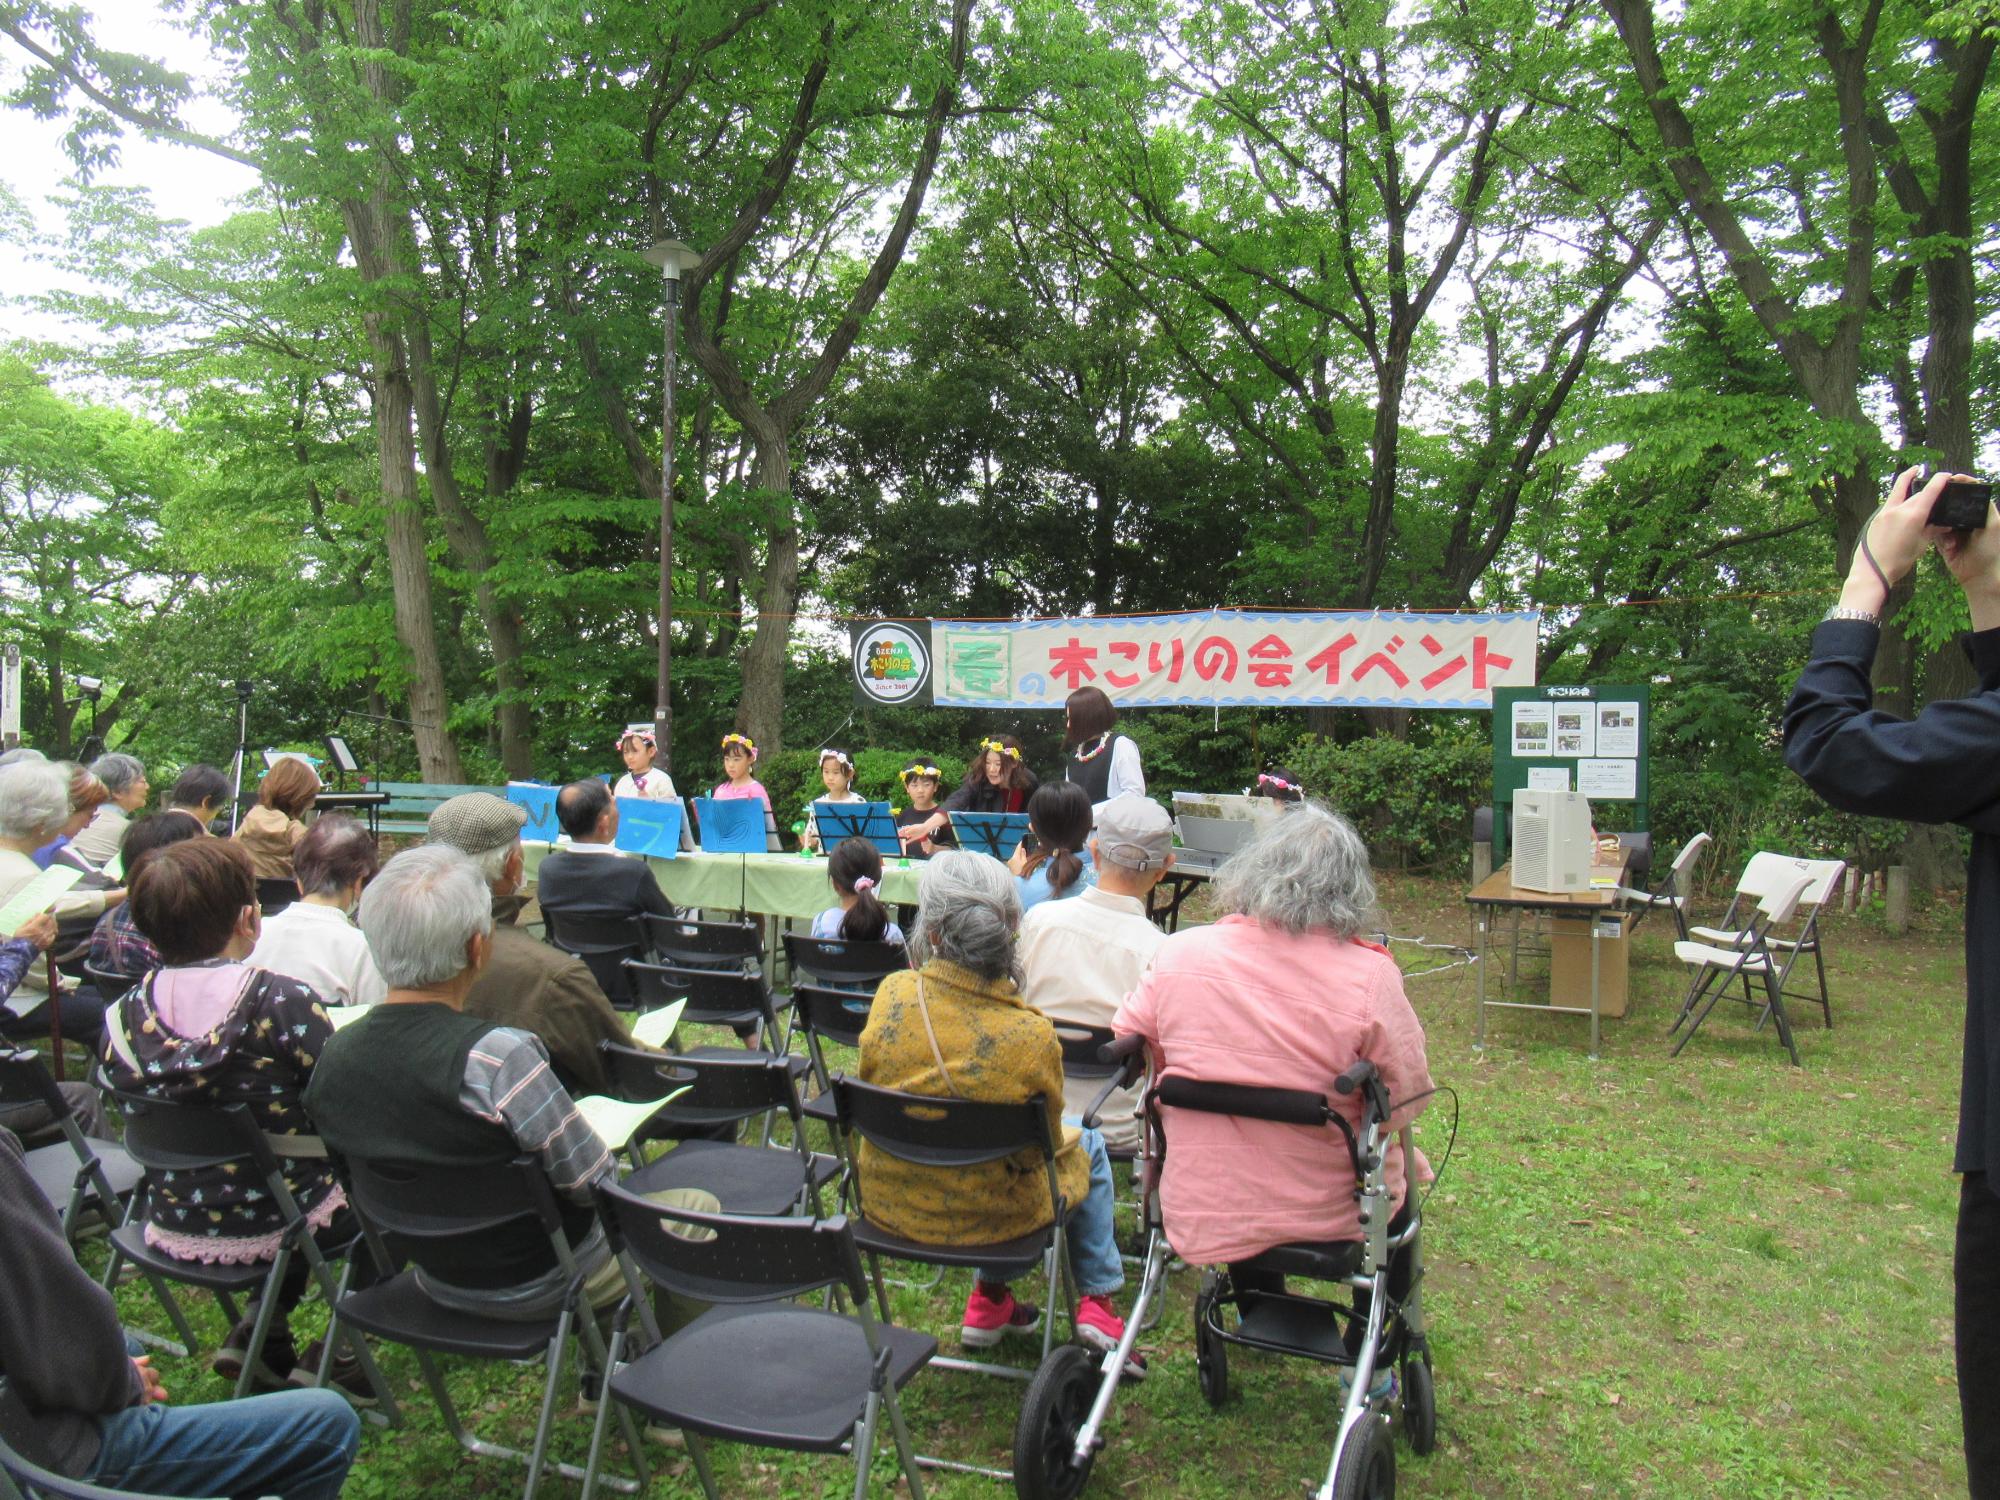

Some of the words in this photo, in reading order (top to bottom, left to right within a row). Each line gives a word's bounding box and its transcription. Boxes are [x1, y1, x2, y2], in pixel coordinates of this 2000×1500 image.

[870, 657, 911, 671] 木こりの会
